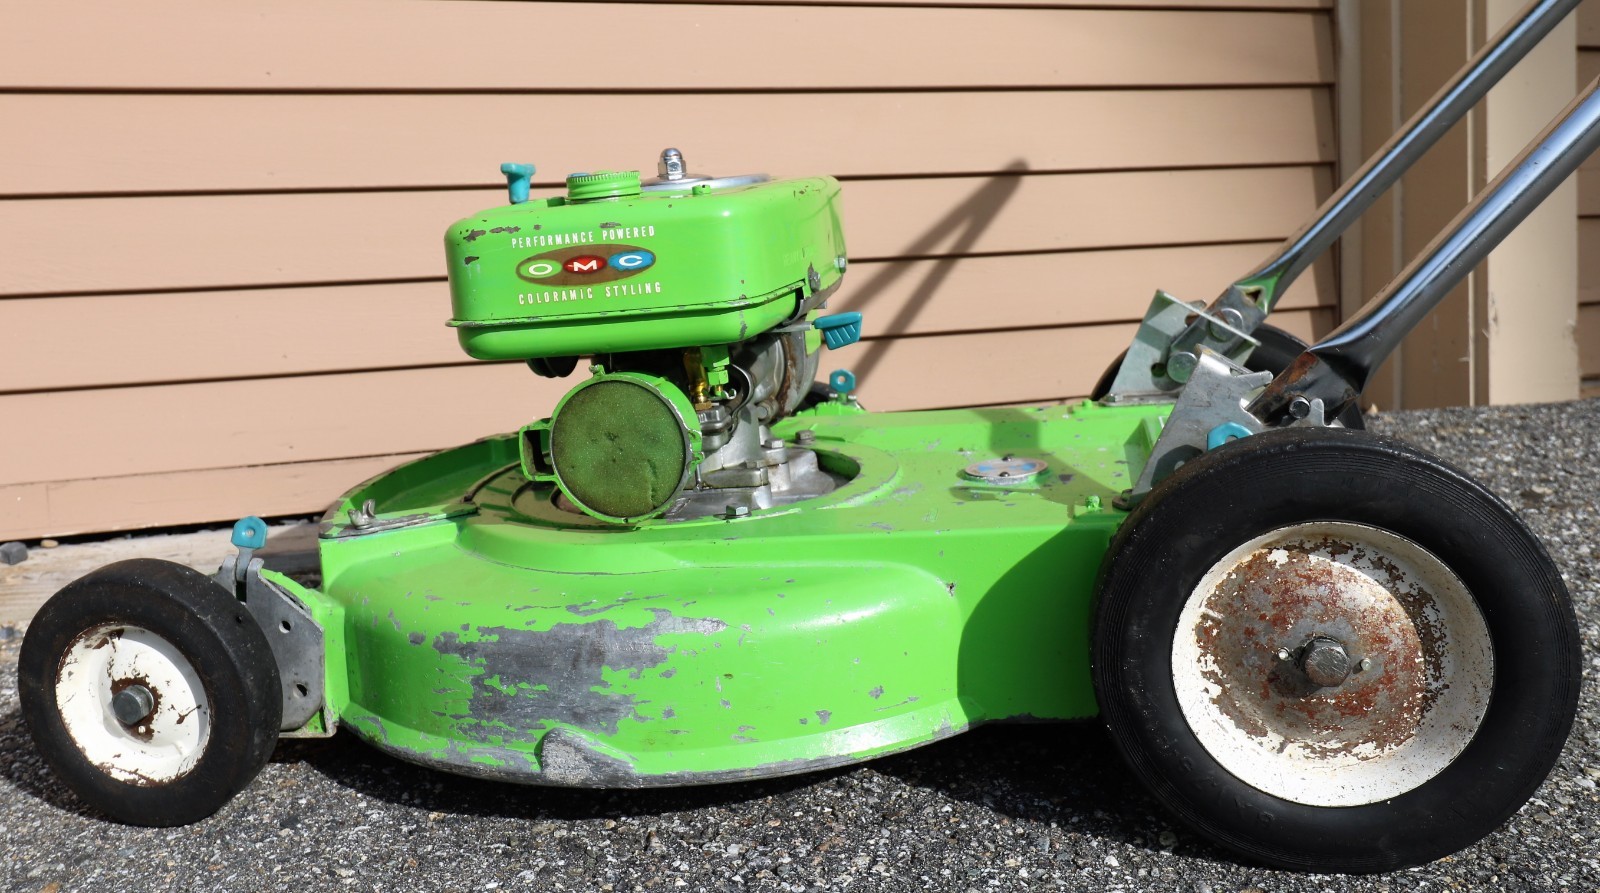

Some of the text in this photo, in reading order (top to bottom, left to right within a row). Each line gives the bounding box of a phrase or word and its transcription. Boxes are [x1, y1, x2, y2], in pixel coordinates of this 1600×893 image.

[511, 225, 655, 249] PERFORMANCE POWERED
[518, 281, 662, 305] COLORAMIC STYLING
